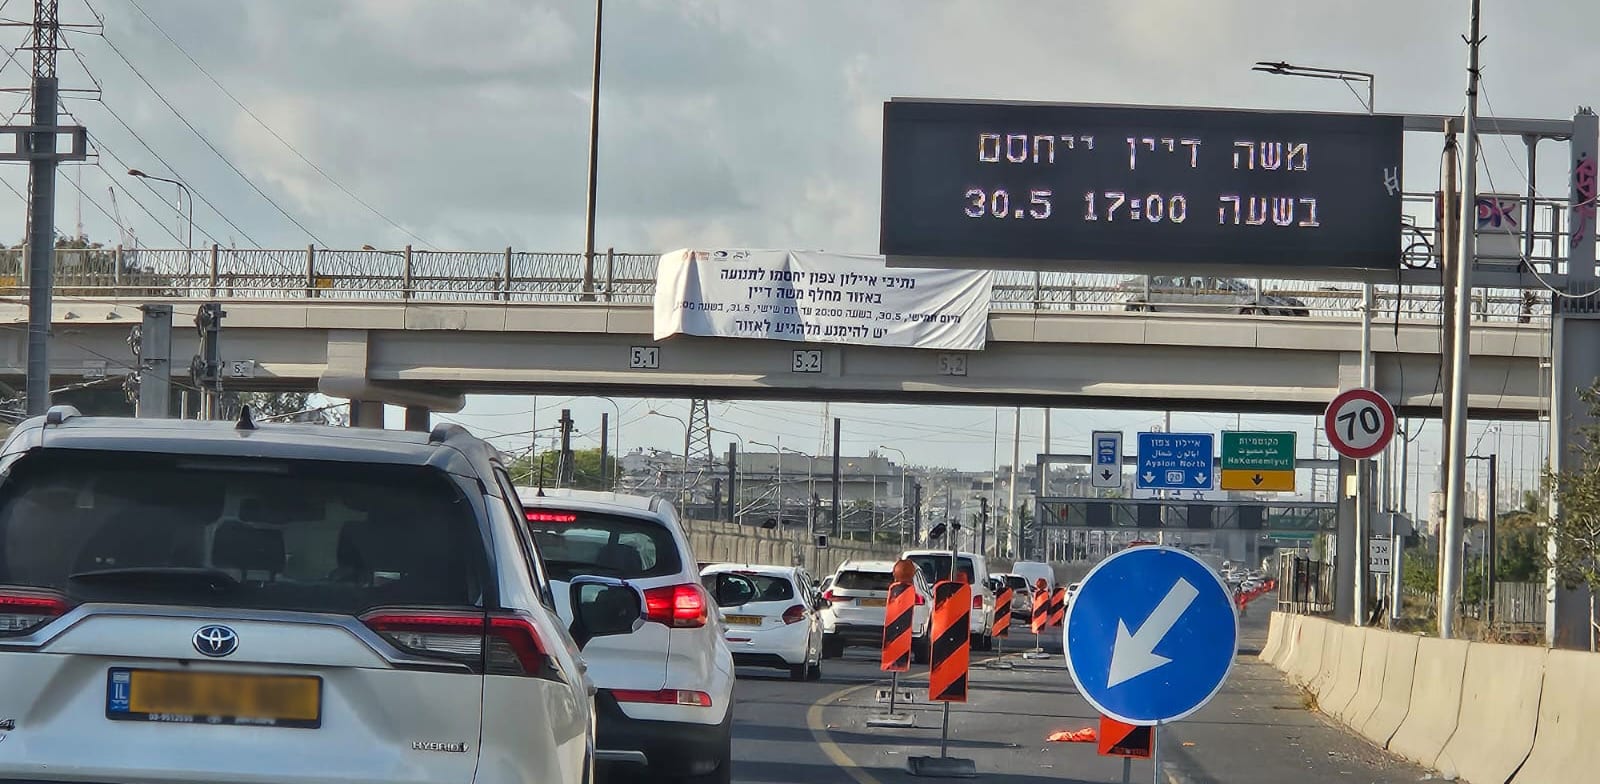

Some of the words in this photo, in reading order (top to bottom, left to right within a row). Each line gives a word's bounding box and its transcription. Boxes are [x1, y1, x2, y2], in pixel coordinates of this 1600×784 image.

[979, 133, 1095, 164] ייחסם
[1126, 136, 1201, 170] דיין
[1234, 141, 1308, 171] משה
[964, 188, 1053, 220] 30.5
[1084, 190, 1187, 224] 17:00
[1219, 195, 1320, 227] בשעה
[720, 267, 766, 280] לתנועה
[769, 270, 806, 283] יחסמו
[809, 272, 835, 285] צפון
[839, 271, 878, 287] איילון
[882, 275, 916, 289] נתיבי
[748, 285, 773, 299] דיין
[776, 287, 804, 300] משה
[807, 288, 842, 303] מחלף
[846, 291, 882, 304] באזור
[698, 302, 724, 312] בשעה
[783, 305, 800, 315] יום
[801, 307, 813, 316] עד
[815, 308, 843, 318] 20:00
[845, 311, 873, 320] בשעה
[736, 319, 771, 332] לאזור
[774, 321, 821, 335] מלהגיע
[824, 326, 870, 338] להימנע
[872, 328, 888, 339] יש
[633, 350, 656, 365] 5.1
[795, 354, 818, 368] 5.2
[1338, 407, 1381, 440] 70
[1179, 460, 1206, 468] North
[115, 683, 127, 699] IL
